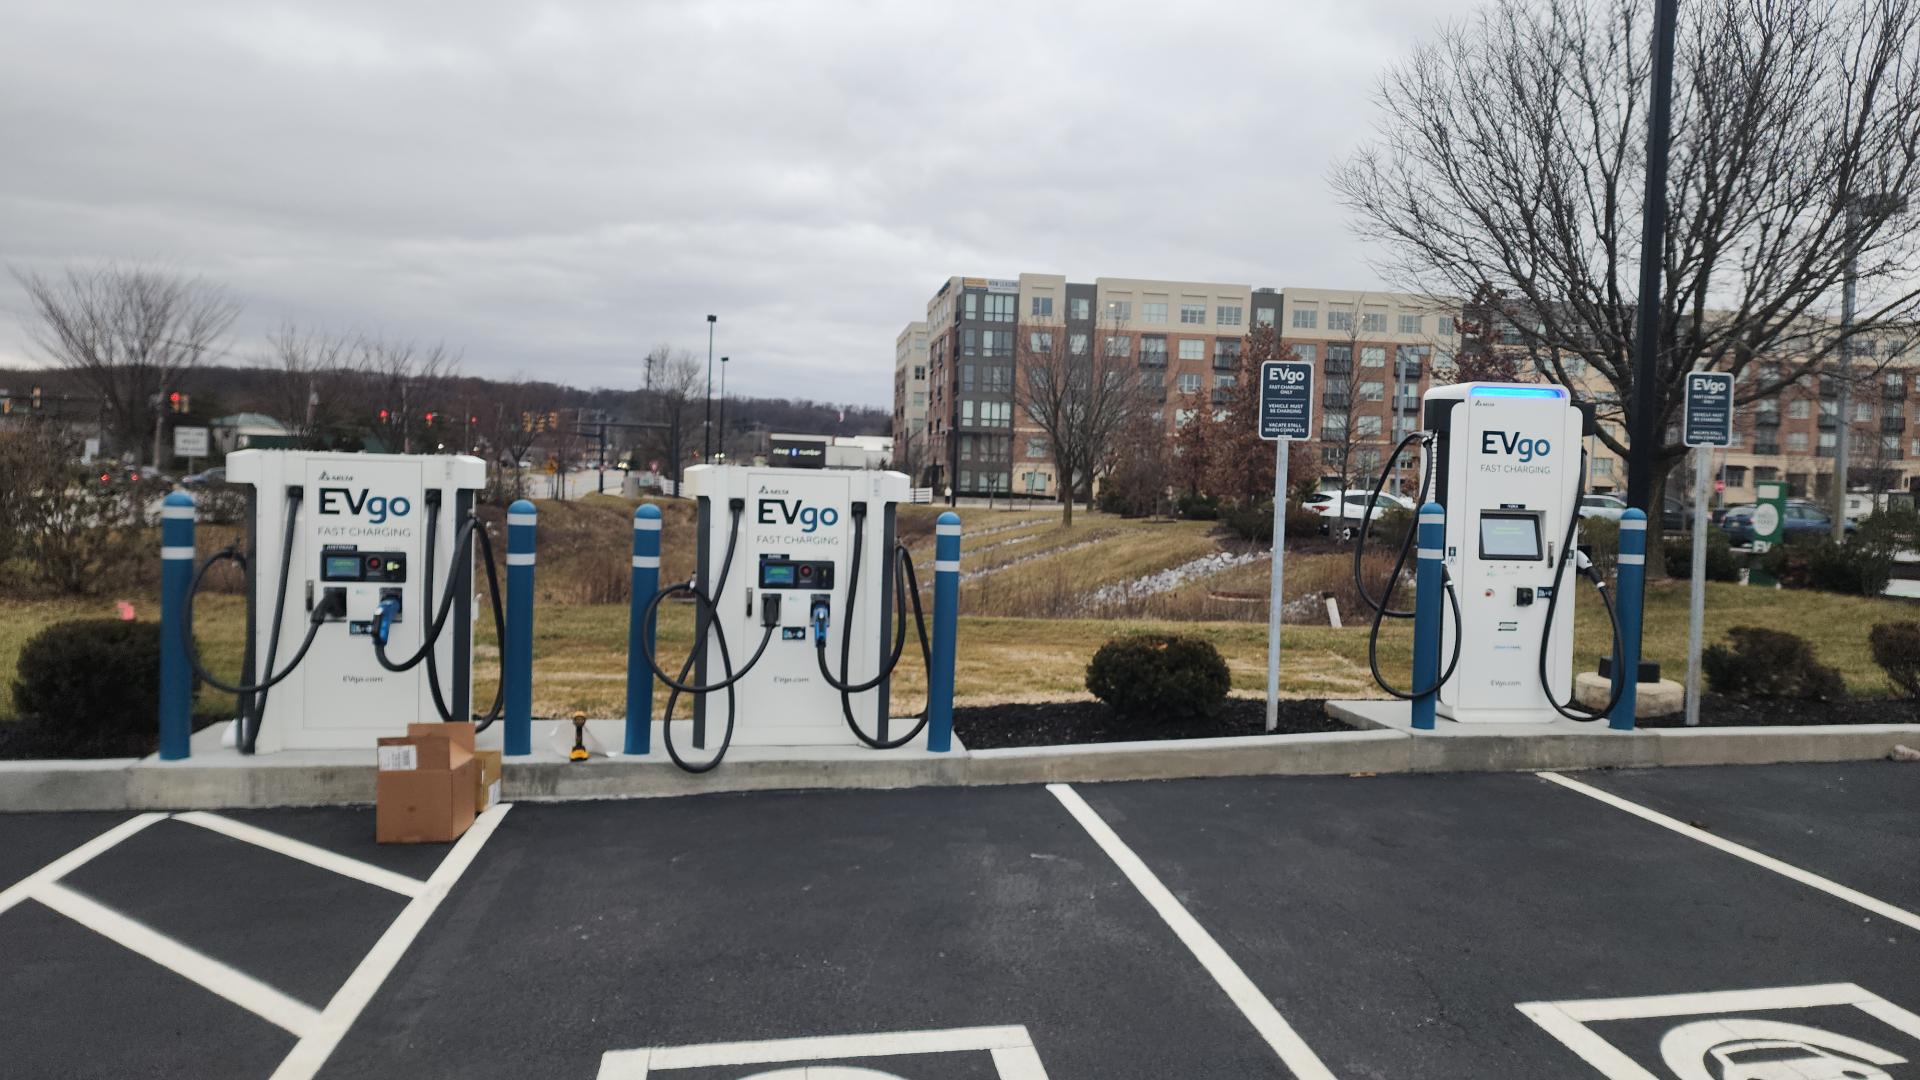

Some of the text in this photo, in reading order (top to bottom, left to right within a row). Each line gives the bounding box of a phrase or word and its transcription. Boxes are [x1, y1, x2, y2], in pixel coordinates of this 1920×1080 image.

[1269, 367, 1305, 384] EVgo
[1693, 378, 1726, 394] EVgo
[1482, 430, 1551, 462] EVgo
[1480, 464, 1551, 474] FAST CHARGING
[318, 487, 411, 524] EVgo
[758, 498, 838, 533] EVgo
[317, 527, 411, 538] FAST CHARGING
[756, 535, 839, 545] FAST CHARGING
